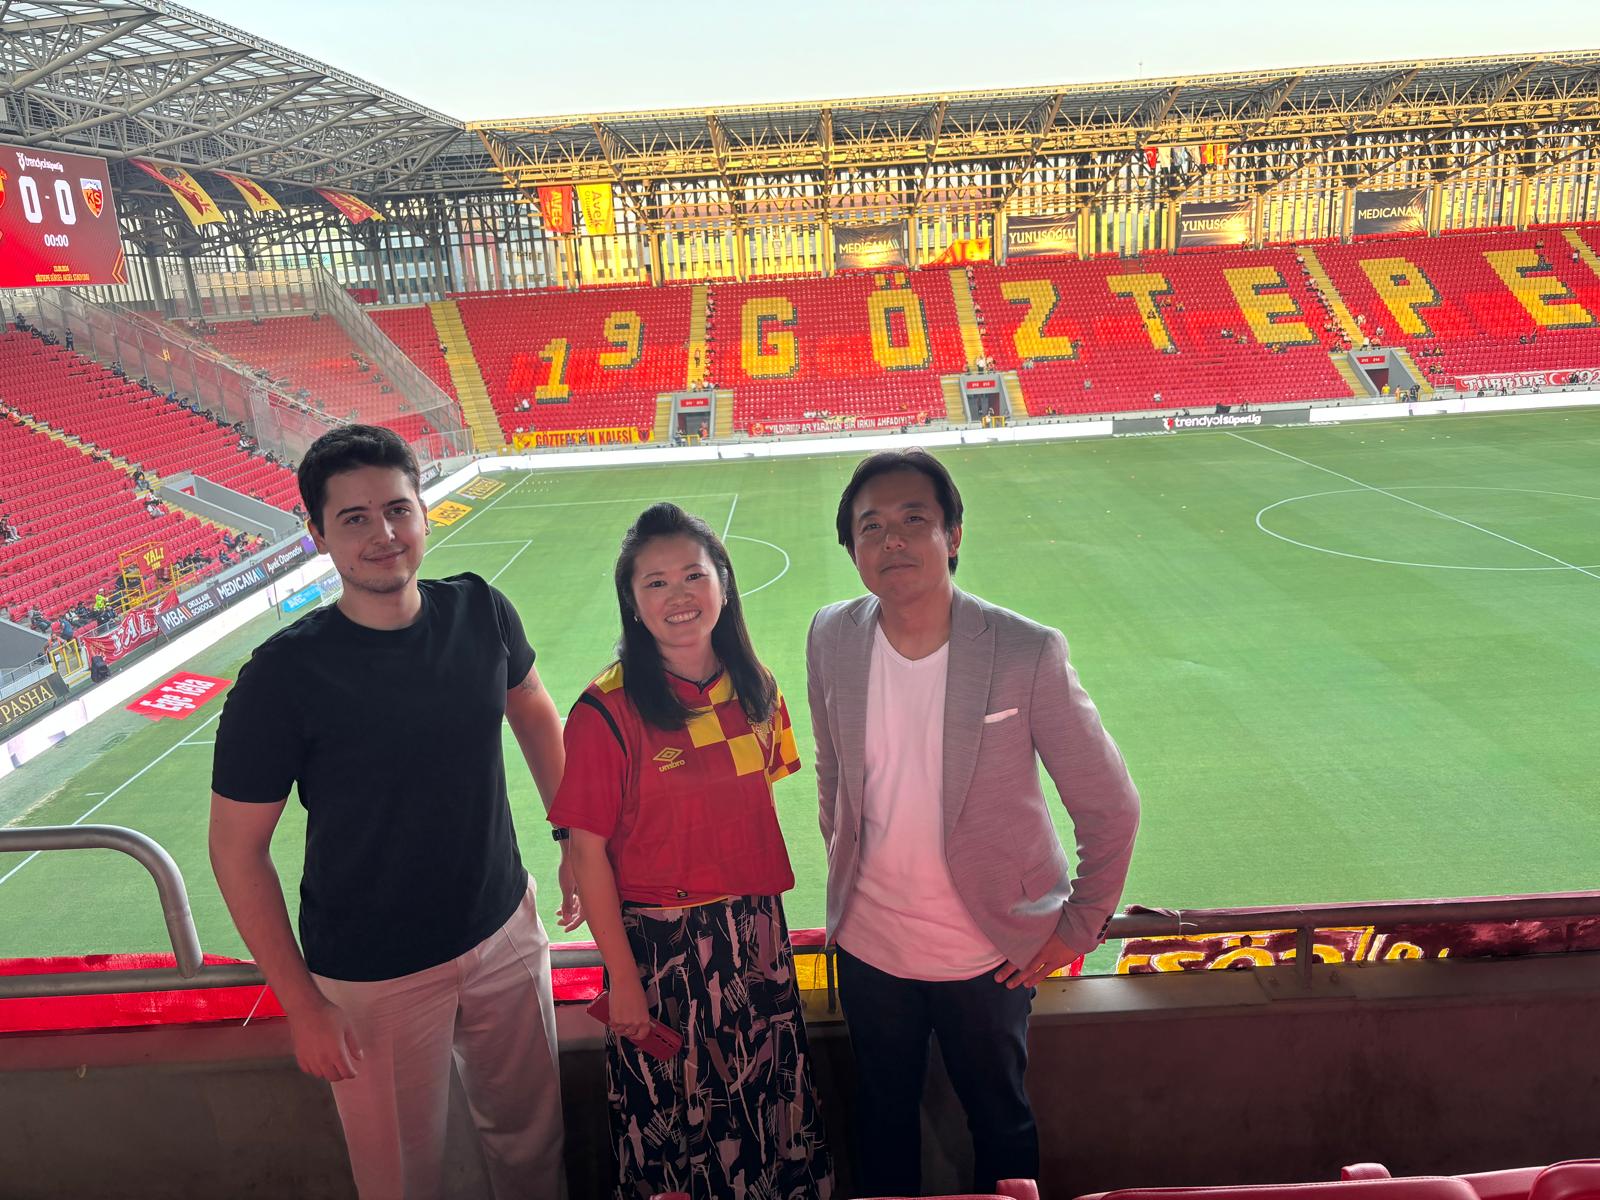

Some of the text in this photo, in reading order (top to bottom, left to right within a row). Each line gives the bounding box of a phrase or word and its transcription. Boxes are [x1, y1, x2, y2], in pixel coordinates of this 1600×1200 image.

[18, 175, 43, 224] 0
[54, 179, 77, 225] 0
[86, 191, 101, 205] KS
[1358, 206, 1413, 220] MEDICANA
[44, 234, 69, 247] 00:00
[216, 569, 260, 600] MEDICANA
[191, 600, 214, 616] SCHOOLS
[161, 607, 188, 630] MBA
[0, 685, 53, 722] PASHA
[659, 760, 686, 772] umbro
